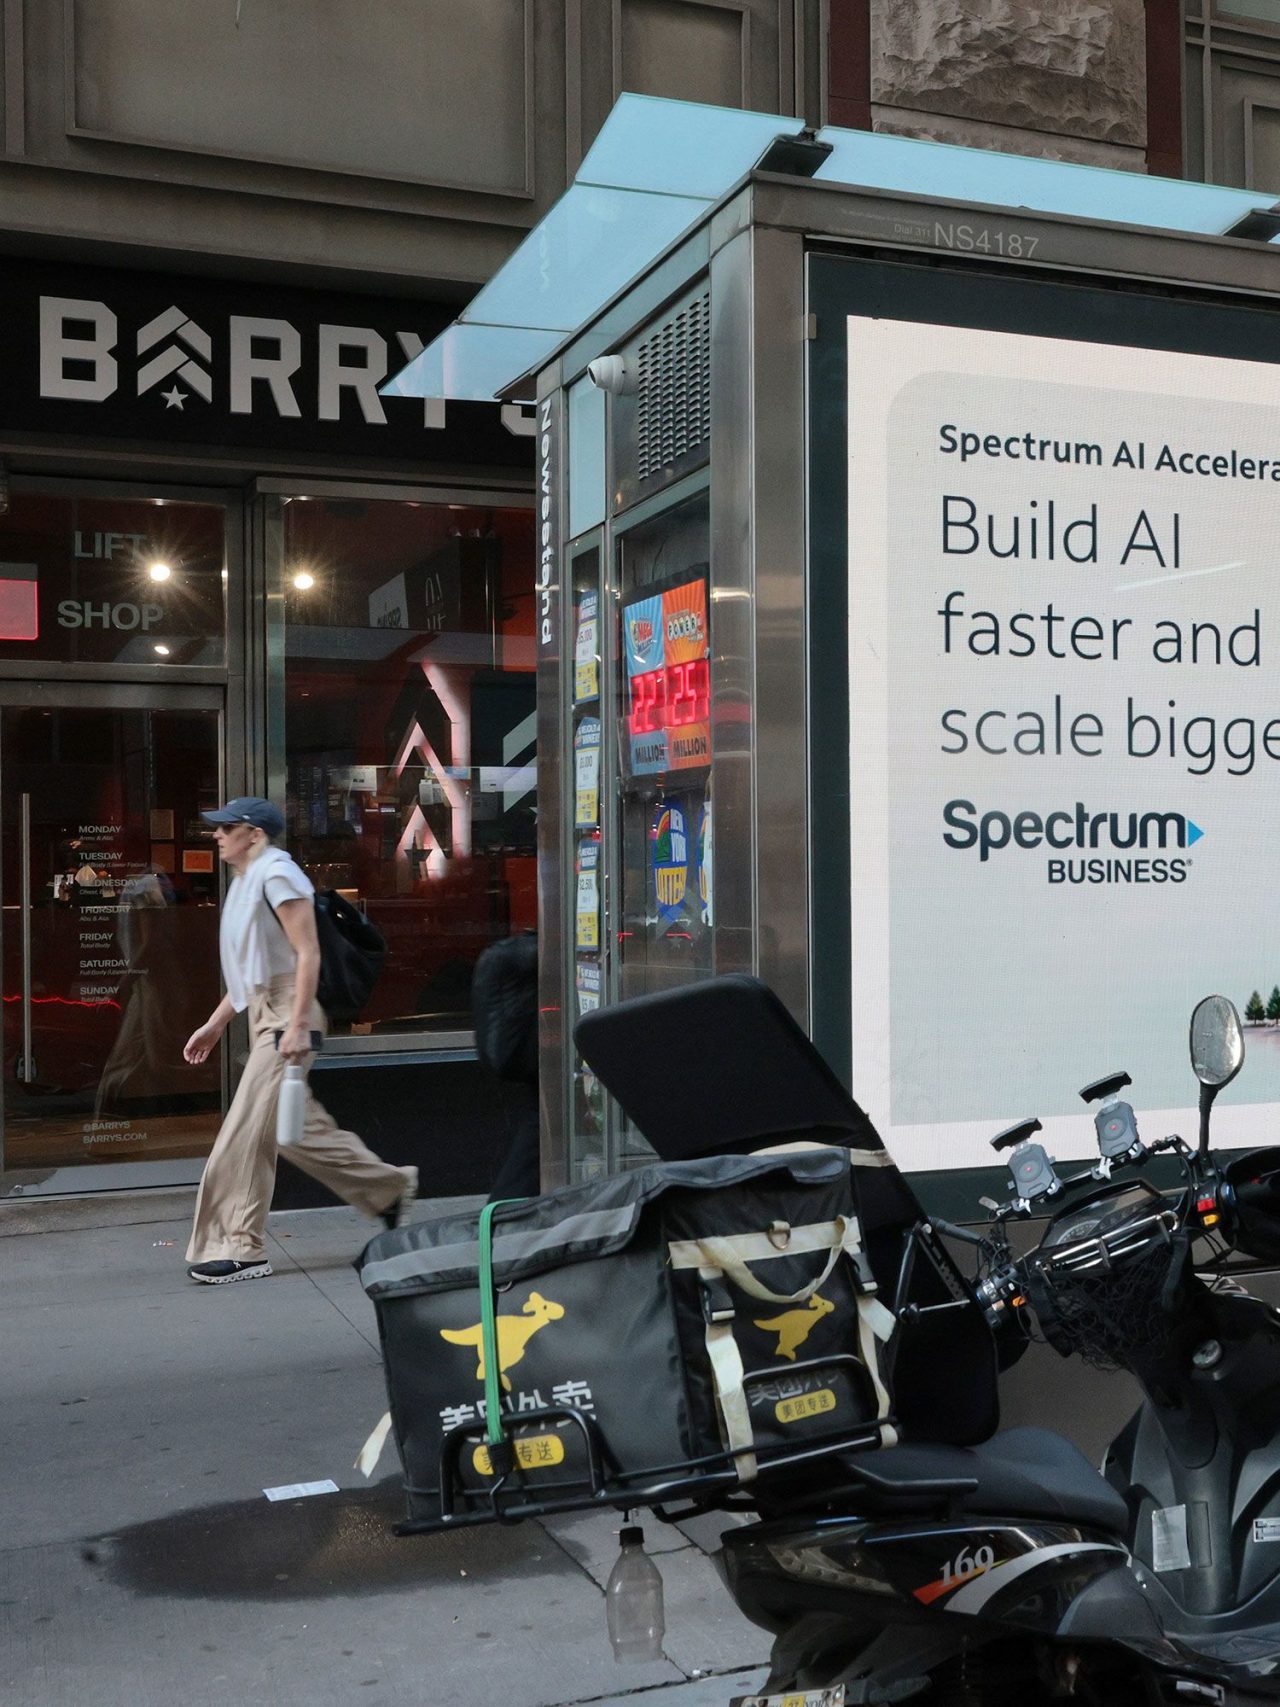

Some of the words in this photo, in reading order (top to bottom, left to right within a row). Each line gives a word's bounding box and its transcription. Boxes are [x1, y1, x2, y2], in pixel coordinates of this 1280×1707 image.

[935, 222, 1039, 258] NS4187
[939, 424, 1102, 465] Spectrum
[1112, 440, 1145, 470] AI
[541, 399, 555, 644] Newsstand
[942, 495, 1098, 564] Build
[1120, 509, 1180, 569] AI
[74, 530, 147, 560] LIFT
[57, 600, 164, 631] SHOP
[937, 591, 1132, 661] faster
[1152, 608, 1261, 667] and
[940, 694, 1103, 757] scale
[673, 736, 706, 758] MILLION
[79, 825, 122, 834] MONDAY
[943, 799, 1186, 862] Spectrum
[79, 852, 123, 861] TUESDAY
[80, 879, 139, 888] DNESDAY
[80, 905, 131, 914] THURSDAY
[80, 932, 114, 941] FRIDAY
[80, 959, 131, 968] SATURDAY
[80, 986, 120, 995] SUNDAY
[83, 1121, 130, 1132] @BARRYS
[83, 1133, 147, 1144] BARRYS.COM
